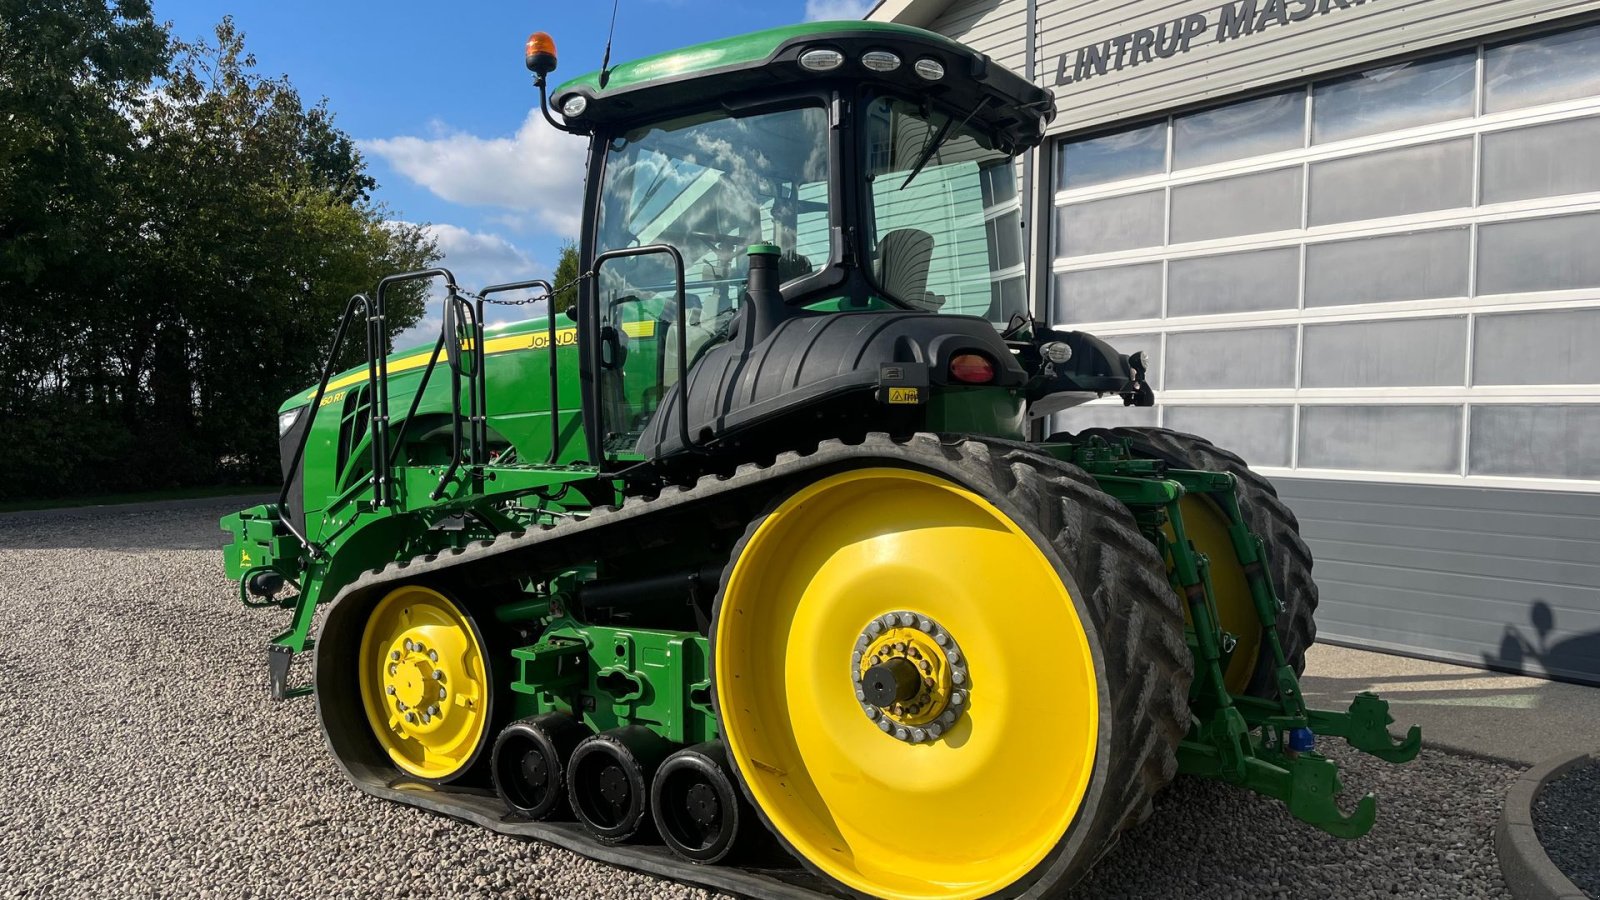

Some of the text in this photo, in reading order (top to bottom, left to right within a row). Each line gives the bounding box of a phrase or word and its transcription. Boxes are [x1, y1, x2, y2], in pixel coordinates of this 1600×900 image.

[1055, 13, 1207, 87] LINTRUP
[528, 331, 578, 348] JOHN DE
[319, 391, 346, 407] 60 RT
